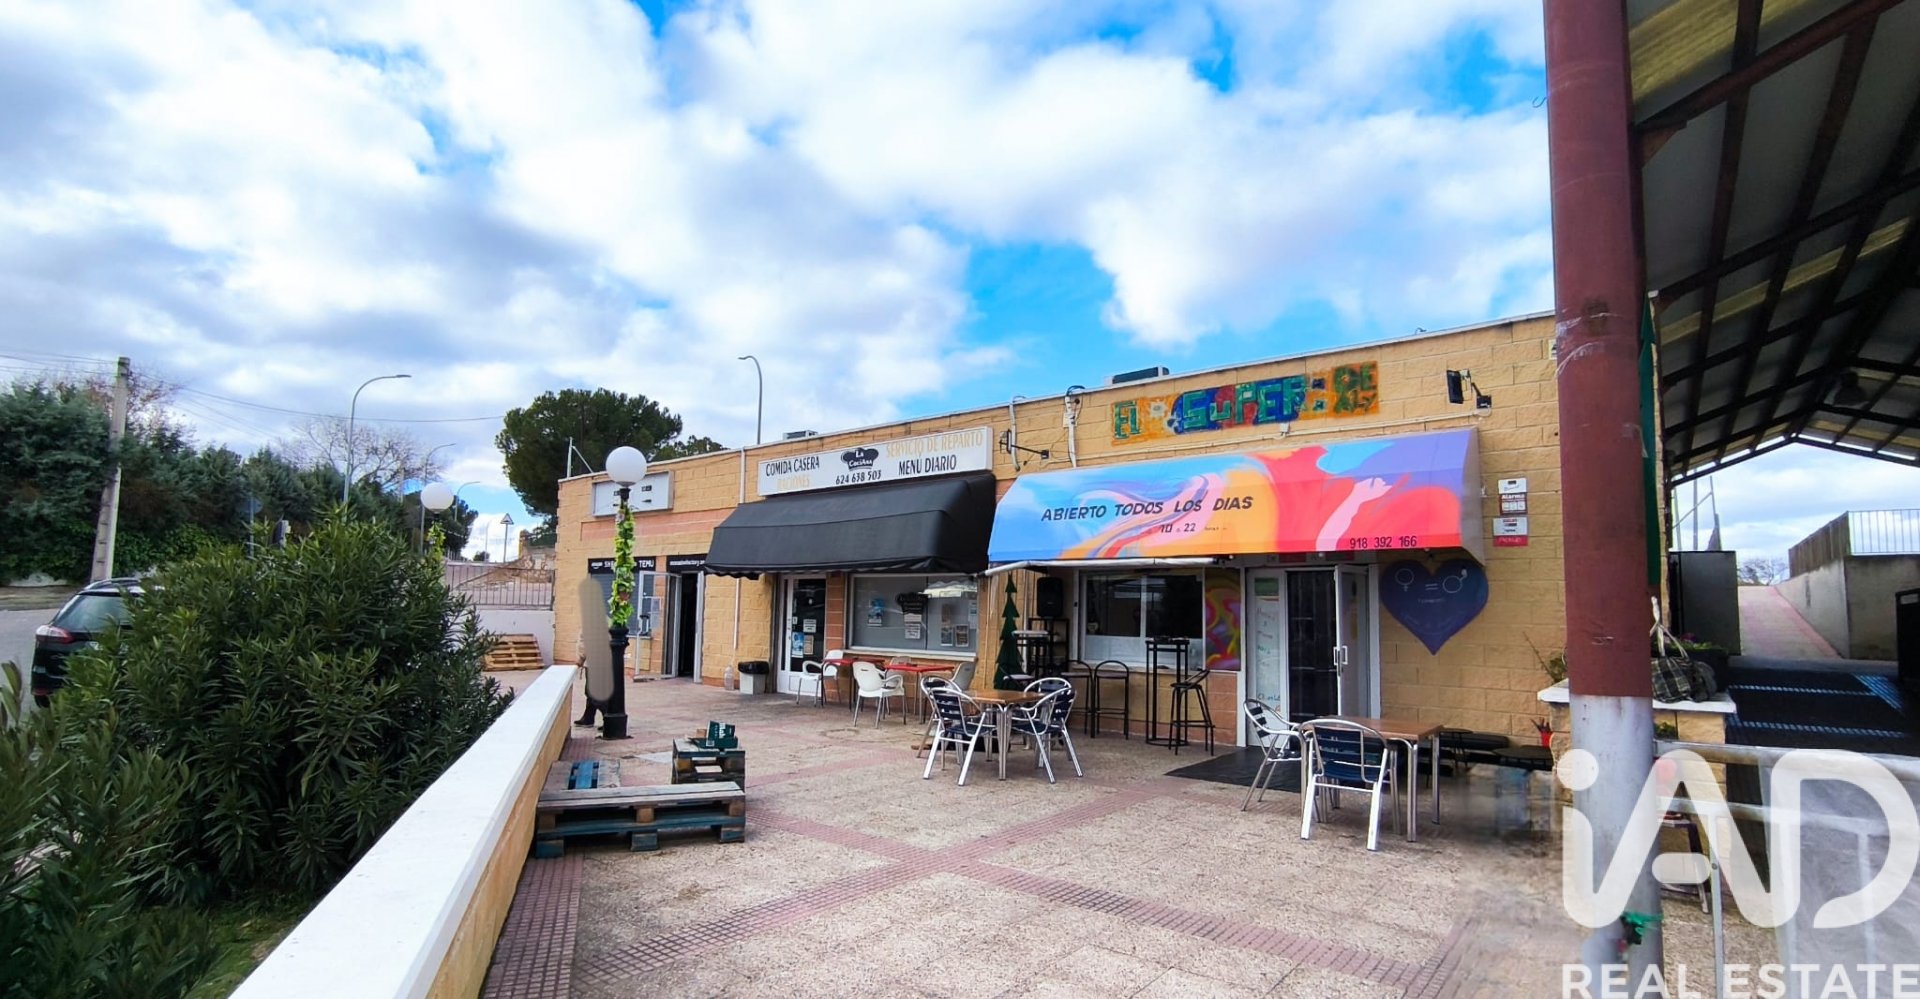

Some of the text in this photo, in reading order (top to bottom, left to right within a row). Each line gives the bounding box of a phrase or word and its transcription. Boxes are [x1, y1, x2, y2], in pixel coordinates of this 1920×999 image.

[886, 431, 983, 458] SERVICIO DE REPARTO
[766, 456, 820, 477] COMIDA CASERA
[925, 454, 957, 473] DIARIO
[835, 470, 881, 485] 624 638 503
[1041, 496, 1253, 521] ABIERTO TODOS LOS DIAS
[1184, 523, 1196, 532] 22
[1349, 535, 1417, 549] 918 392 166
[638, 559, 654, 568] TEMU
